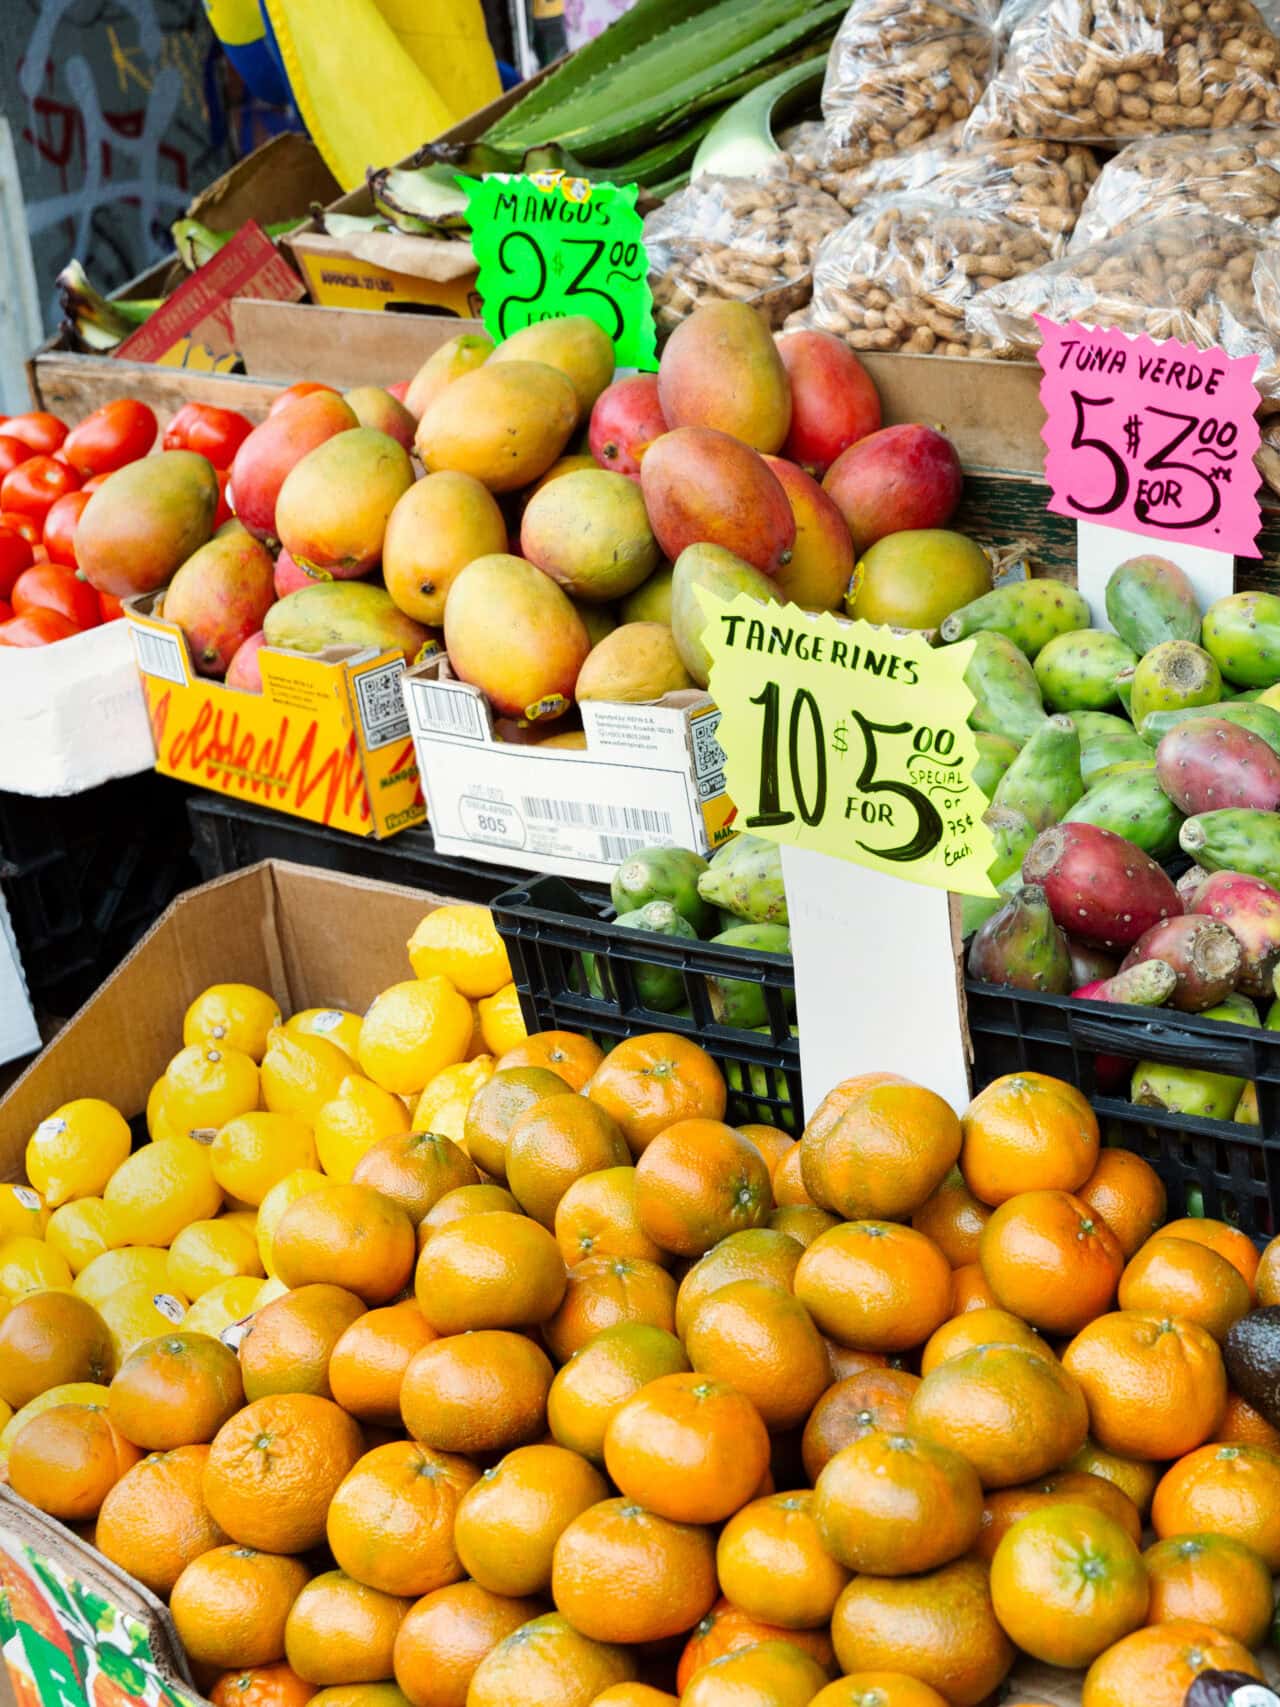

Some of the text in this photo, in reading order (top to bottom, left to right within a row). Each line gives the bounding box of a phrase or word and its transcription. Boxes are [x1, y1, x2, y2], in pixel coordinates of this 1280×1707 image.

[1059, 341, 1225, 395] TUNA VERDE
[1066, 390, 1130, 515] 5
[1136, 479, 1183, 508] FOR
[721, 615, 920, 685] TANGERINES
[746, 681, 827, 828] 10
[909, 769, 963, 785] SPECIAL
[478, 814, 507, 834] 805
[845, 796, 895, 826] FOR
[944, 843, 973, 866] Each
